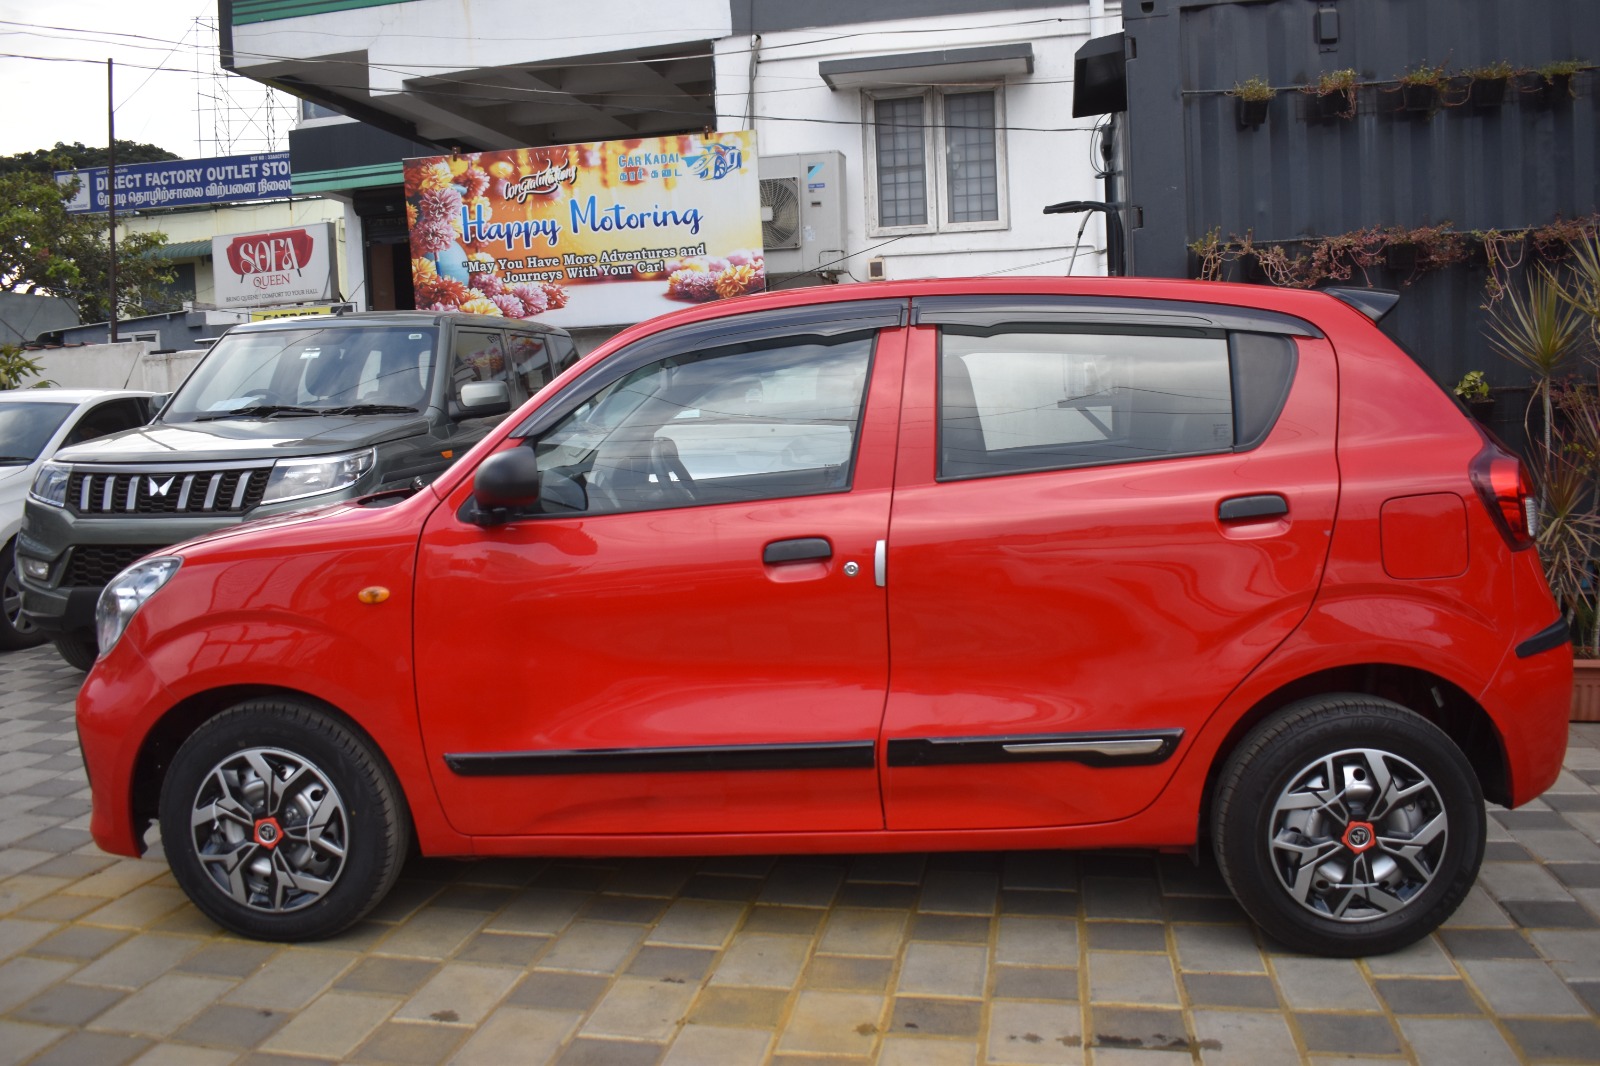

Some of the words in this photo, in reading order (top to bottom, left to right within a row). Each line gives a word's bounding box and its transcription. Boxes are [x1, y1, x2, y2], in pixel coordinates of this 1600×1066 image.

[145, 168, 203, 187] FACTORY
[206, 163, 258, 181] OUTLET
[262, 160, 291, 177] STO
[618, 155, 642, 168] CAR
[644, 153, 680, 166] KADAI
[503, 158, 578, 203] Congratulations
[128, 185, 204, 207] தொழிற்சாலை
[205, 182, 256, 200] விற்பனை
[461, 204, 561, 250] Happy
[569, 195, 704, 235] Motoring
[239, 237, 299, 274] SOFA
[462, 260, 495, 274] "May
[499, 258, 524, 270] You
[526, 256, 560, 268] Have
[563, 254, 597, 265] More
[600, 247, 676, 263] Adventures
[680, 243, 706, 257] and
[253, 273, 291, 290] QUEEN
[503, 269, 563, 283] Journeys
[567, 266, 598, 279] With
[603, 264, 633, 276] Your
[637, 261, 665, 273] Car!
